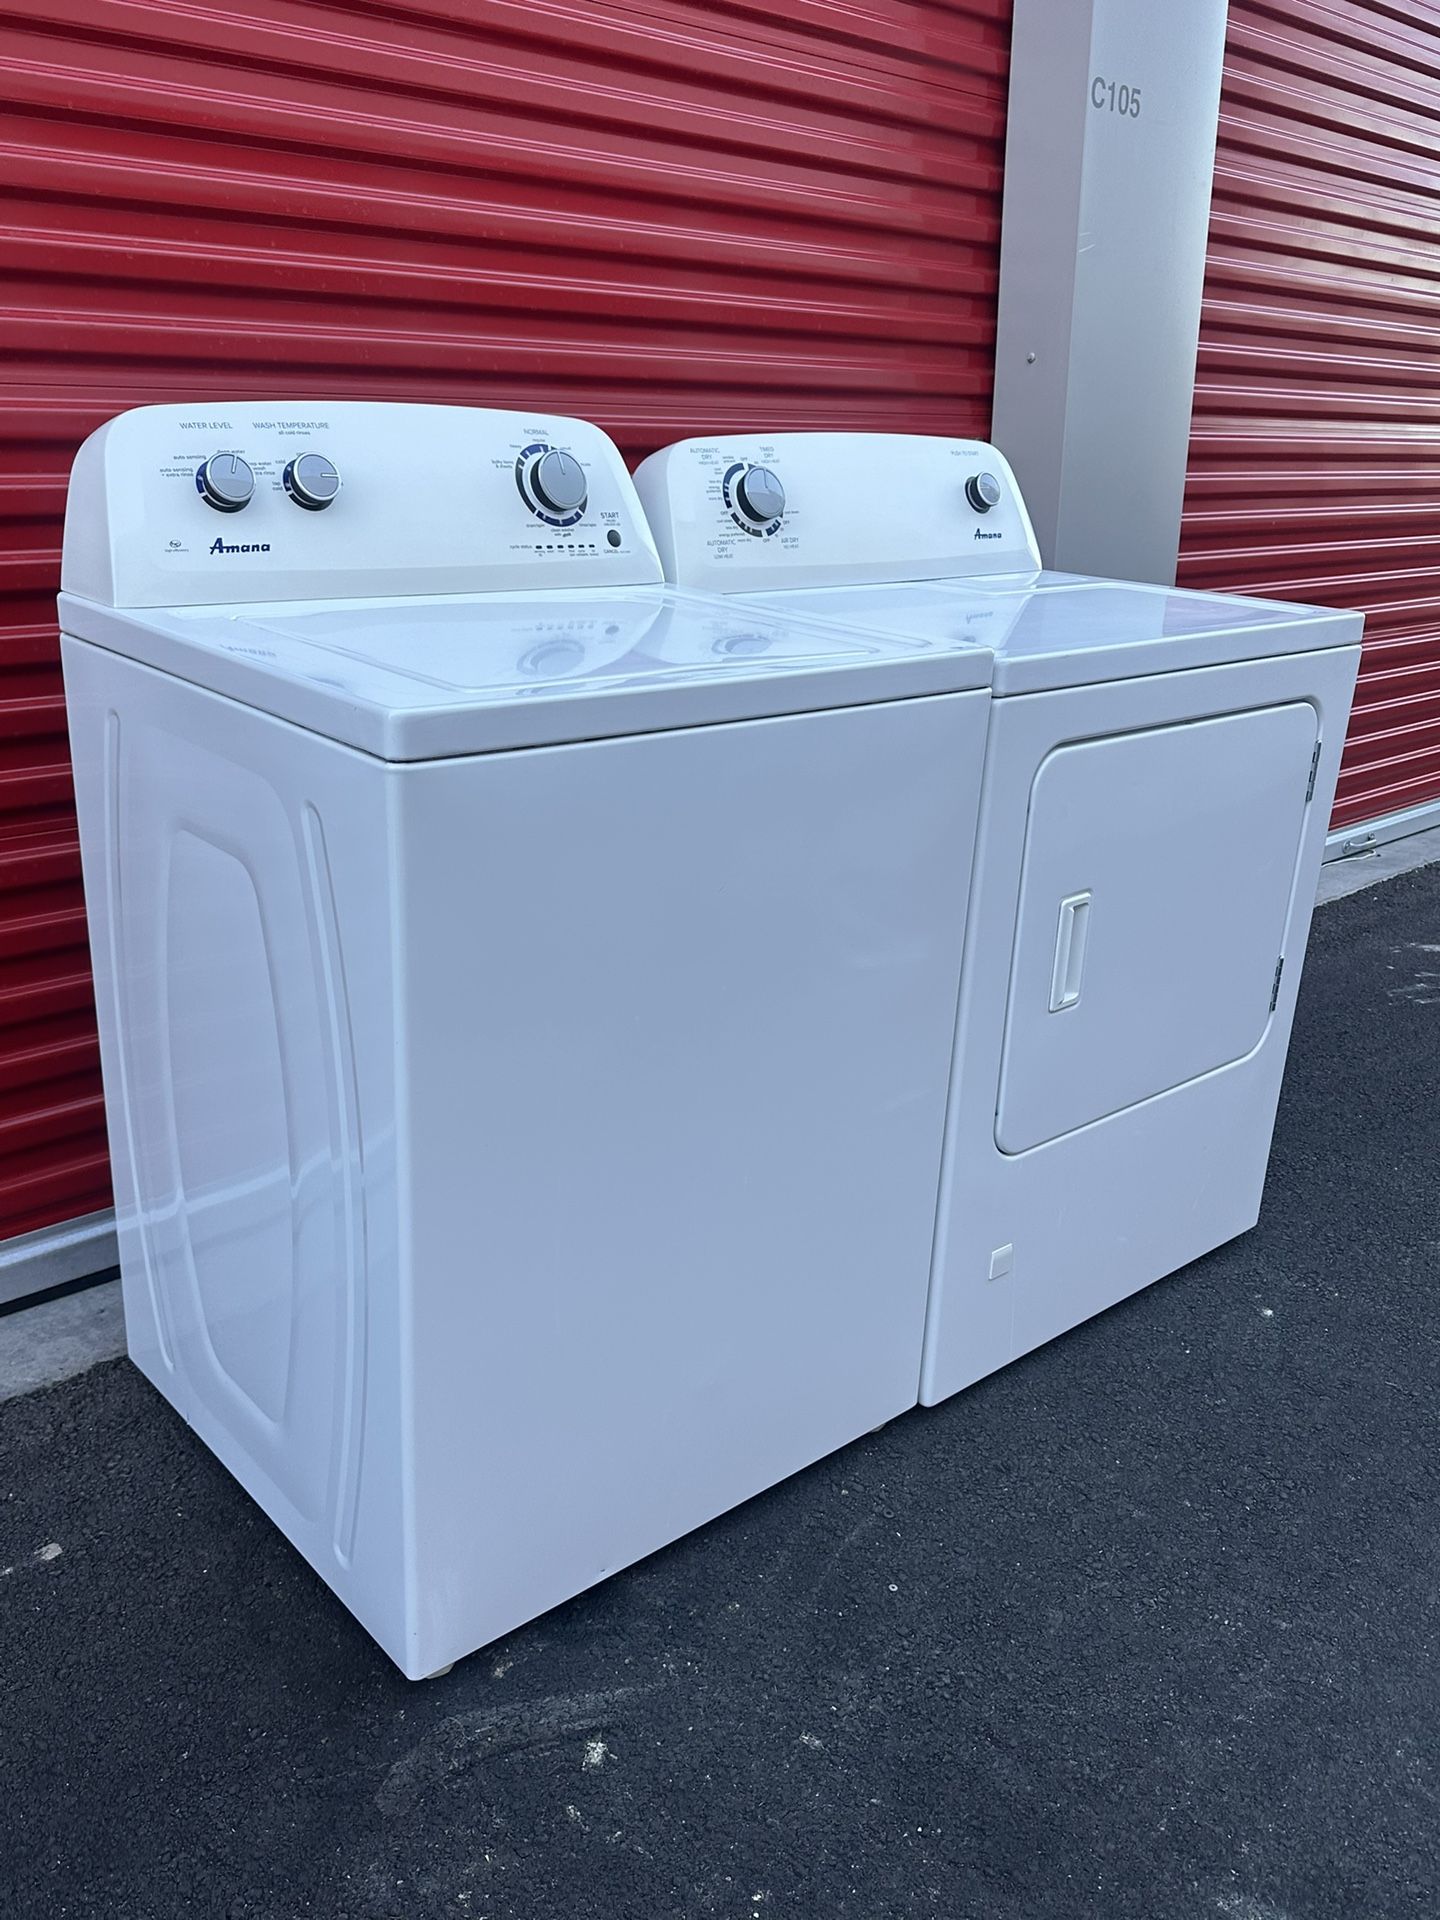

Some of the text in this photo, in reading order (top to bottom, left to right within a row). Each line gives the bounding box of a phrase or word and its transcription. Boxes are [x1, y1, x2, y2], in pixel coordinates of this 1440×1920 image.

[1091, 76, 1141, 118] C105
[179, 422, 233, 430] WATER LEVEL
[252, 422, 330, 430] WASH TEMPERATURE
[523, 428, 549, 436] NORMAL
[974, 528, 1002, 540] Amana
[209, 537, 271, 555] Amana
